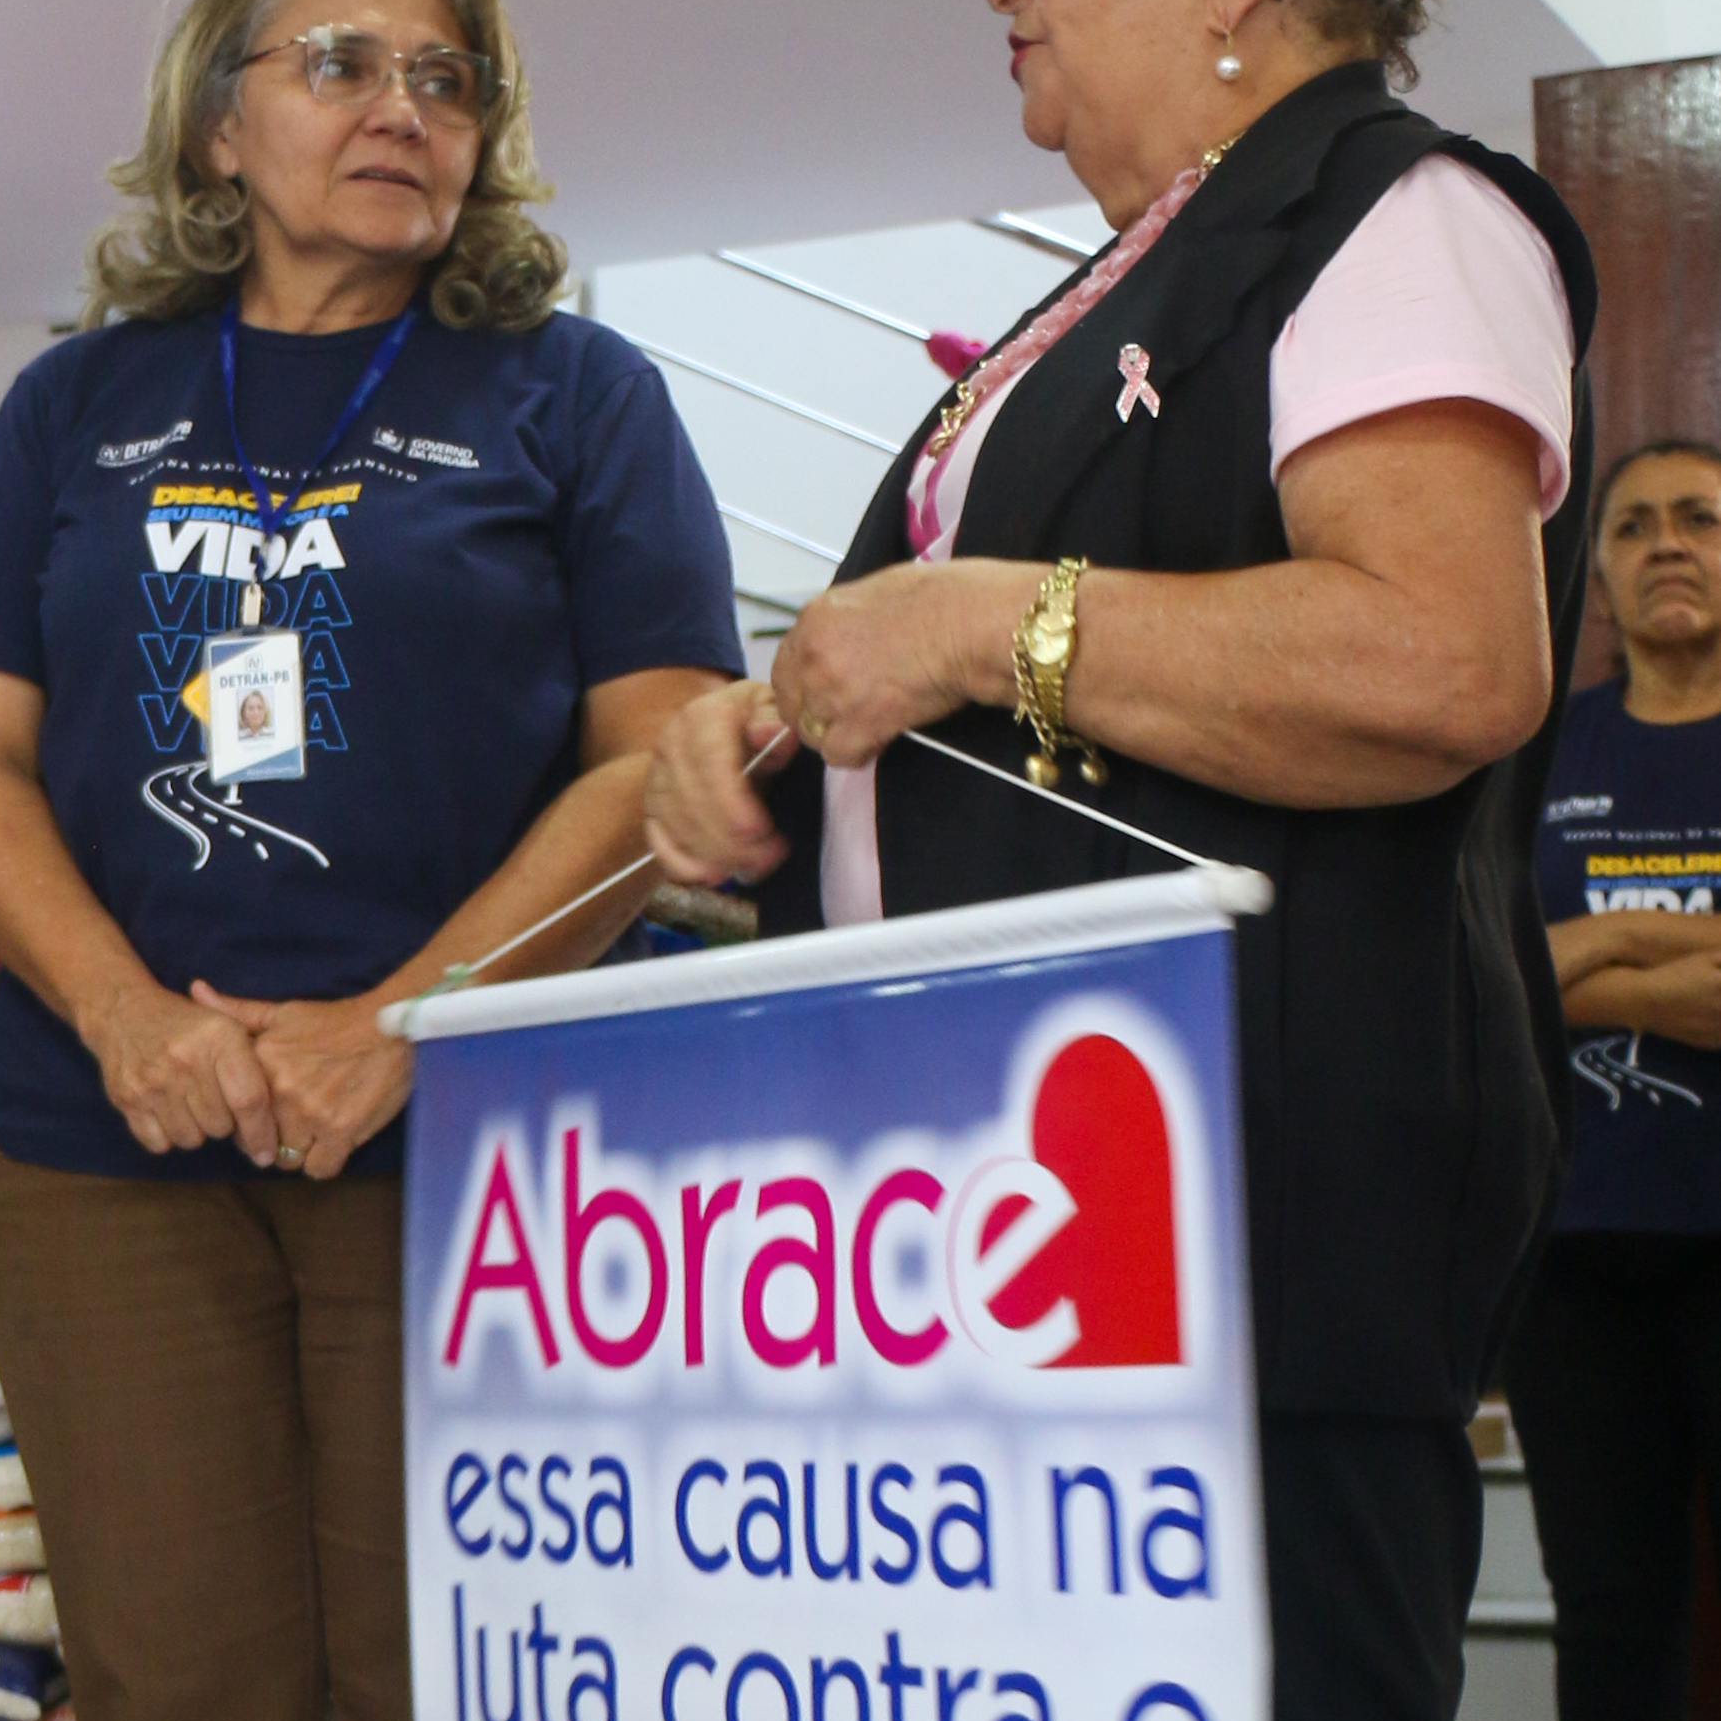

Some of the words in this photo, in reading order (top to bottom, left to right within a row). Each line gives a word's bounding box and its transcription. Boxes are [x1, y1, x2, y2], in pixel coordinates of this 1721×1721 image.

[199, 461, 291, 480] NACINAL
[407, 447, 426, 460] DA
[410, 438, 474, 459] GOVERNO
[152, 483, 362, 512] DESACEERE!
[190, 505, 238, 527] BEM
[240, 508, 317, 531] MOR
[145, 518, 347, 581] VIDA
[141, 570, 354, 632] VIDA
[137, 630, 352, 692] VA
[137, 691, 350, 753] VA
[1586, 852, 1721, 876] DESACELER
[441, 1127, 1082, 1371] Abrace
[444, 1451, 634, 1568] essa
[674, 1458, 993, 1591] causa
[1049, 1465, 1216, 1601] na
